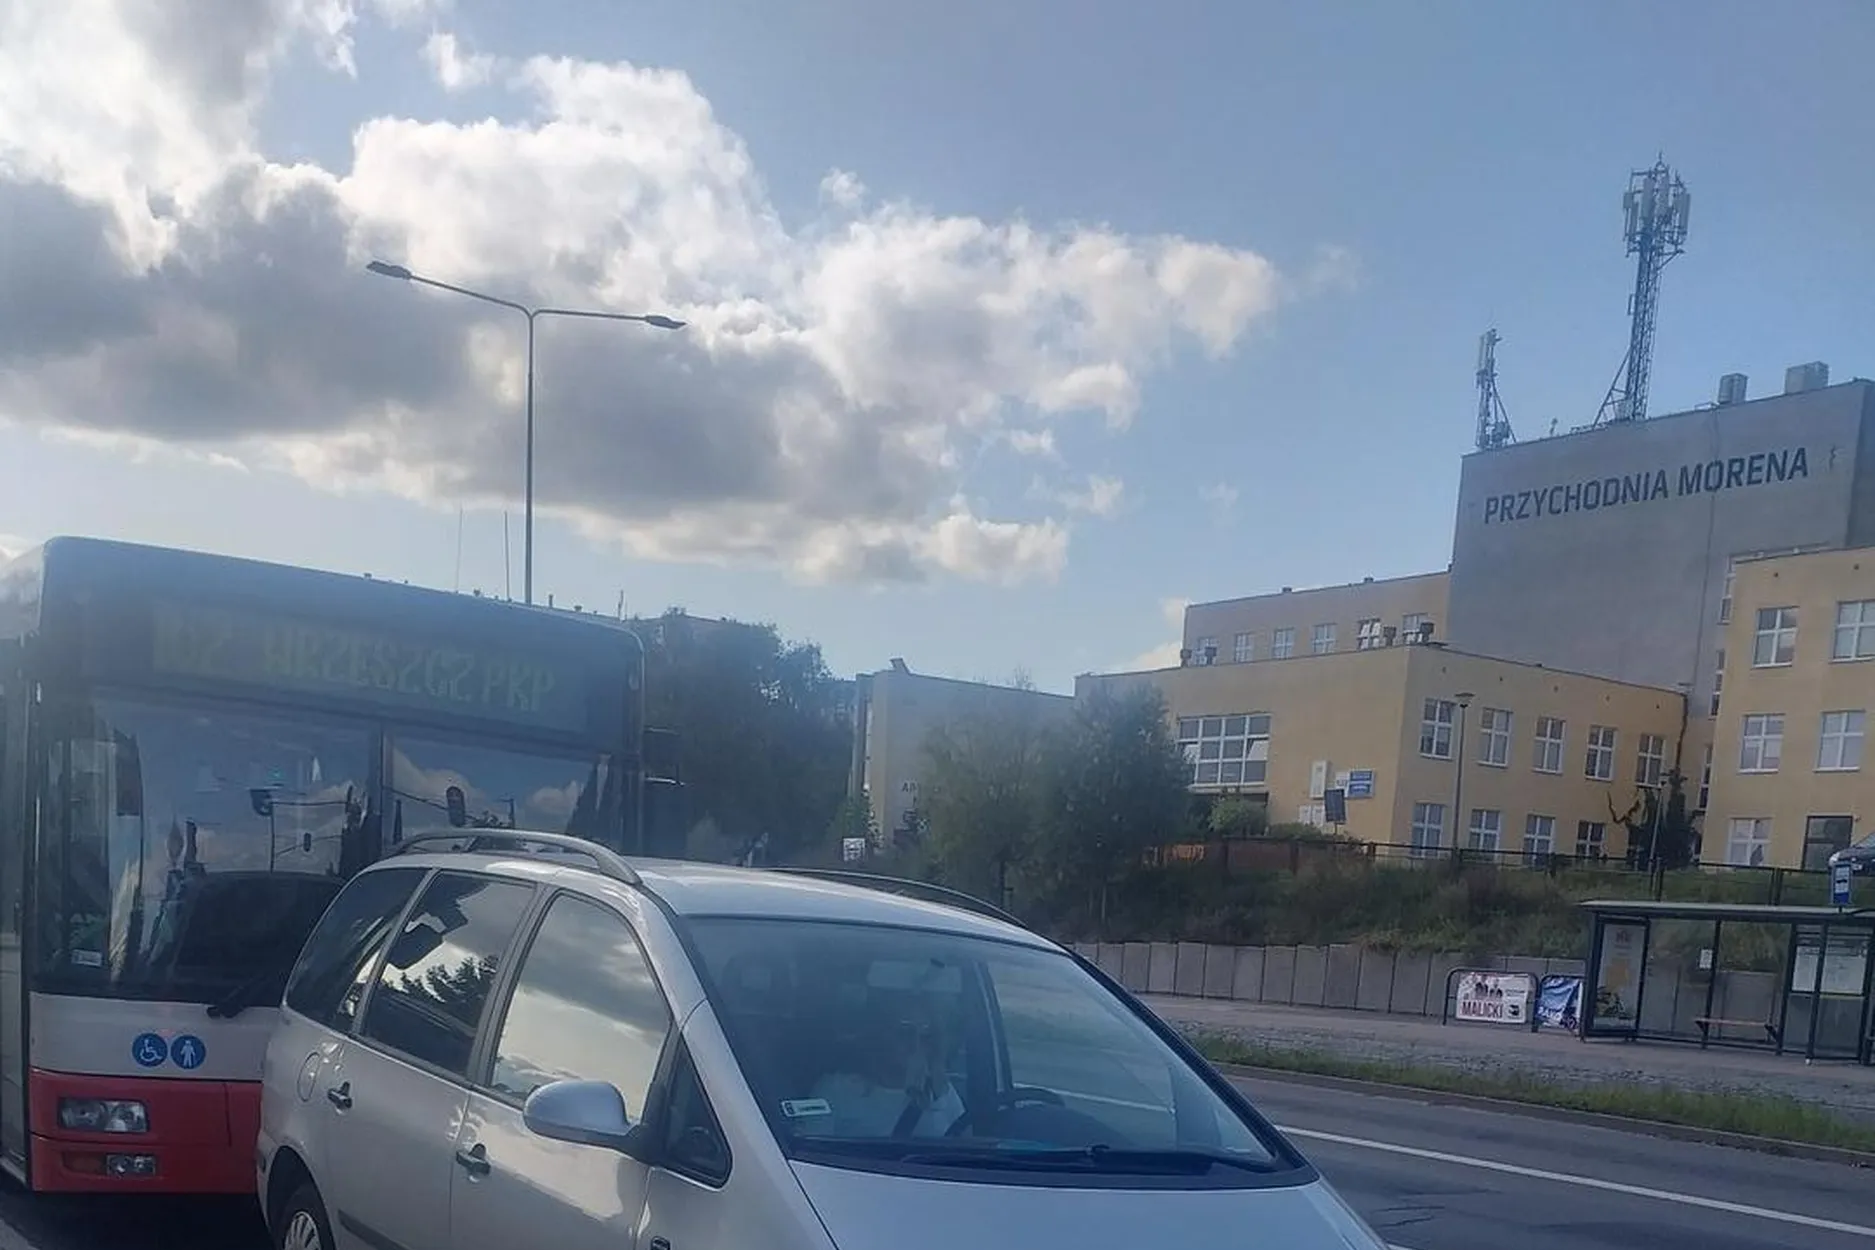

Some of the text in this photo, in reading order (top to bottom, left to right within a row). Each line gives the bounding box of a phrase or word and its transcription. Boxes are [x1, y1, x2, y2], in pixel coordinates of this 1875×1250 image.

[1484, 447, 1808, 524] PRZYCHODNIA MORENA
[263, 620, 475, 702] WRZESZCZ
[481, 659, 556, 713] PKP
